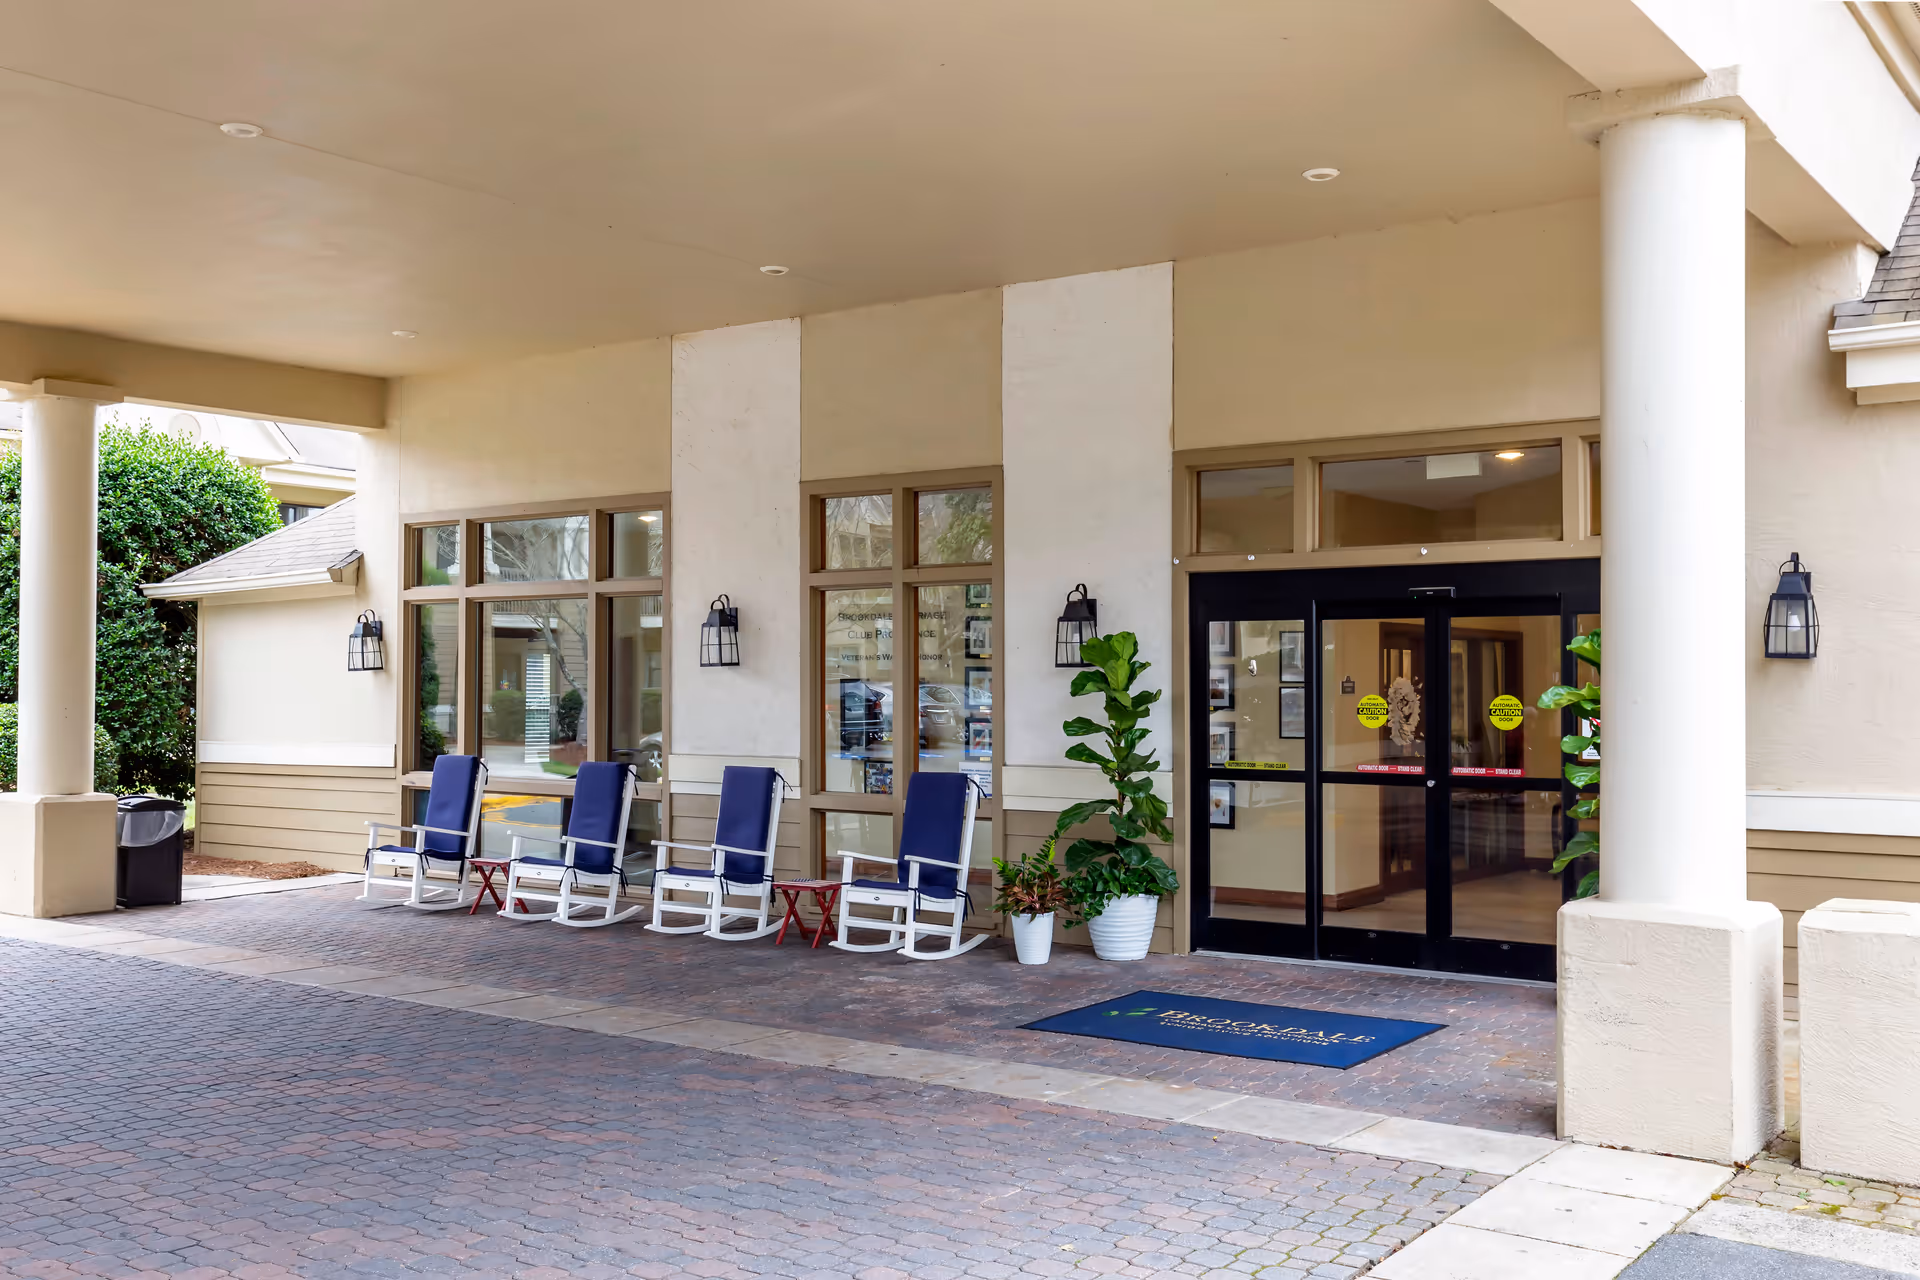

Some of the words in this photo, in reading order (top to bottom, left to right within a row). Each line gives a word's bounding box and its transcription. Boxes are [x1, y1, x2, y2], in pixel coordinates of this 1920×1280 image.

[838, 612, 893, 621] BROOKDALE
[848, 630, 873, 639] CLUB
[1157, 1009, 1375, 1042] BROOKDALE
